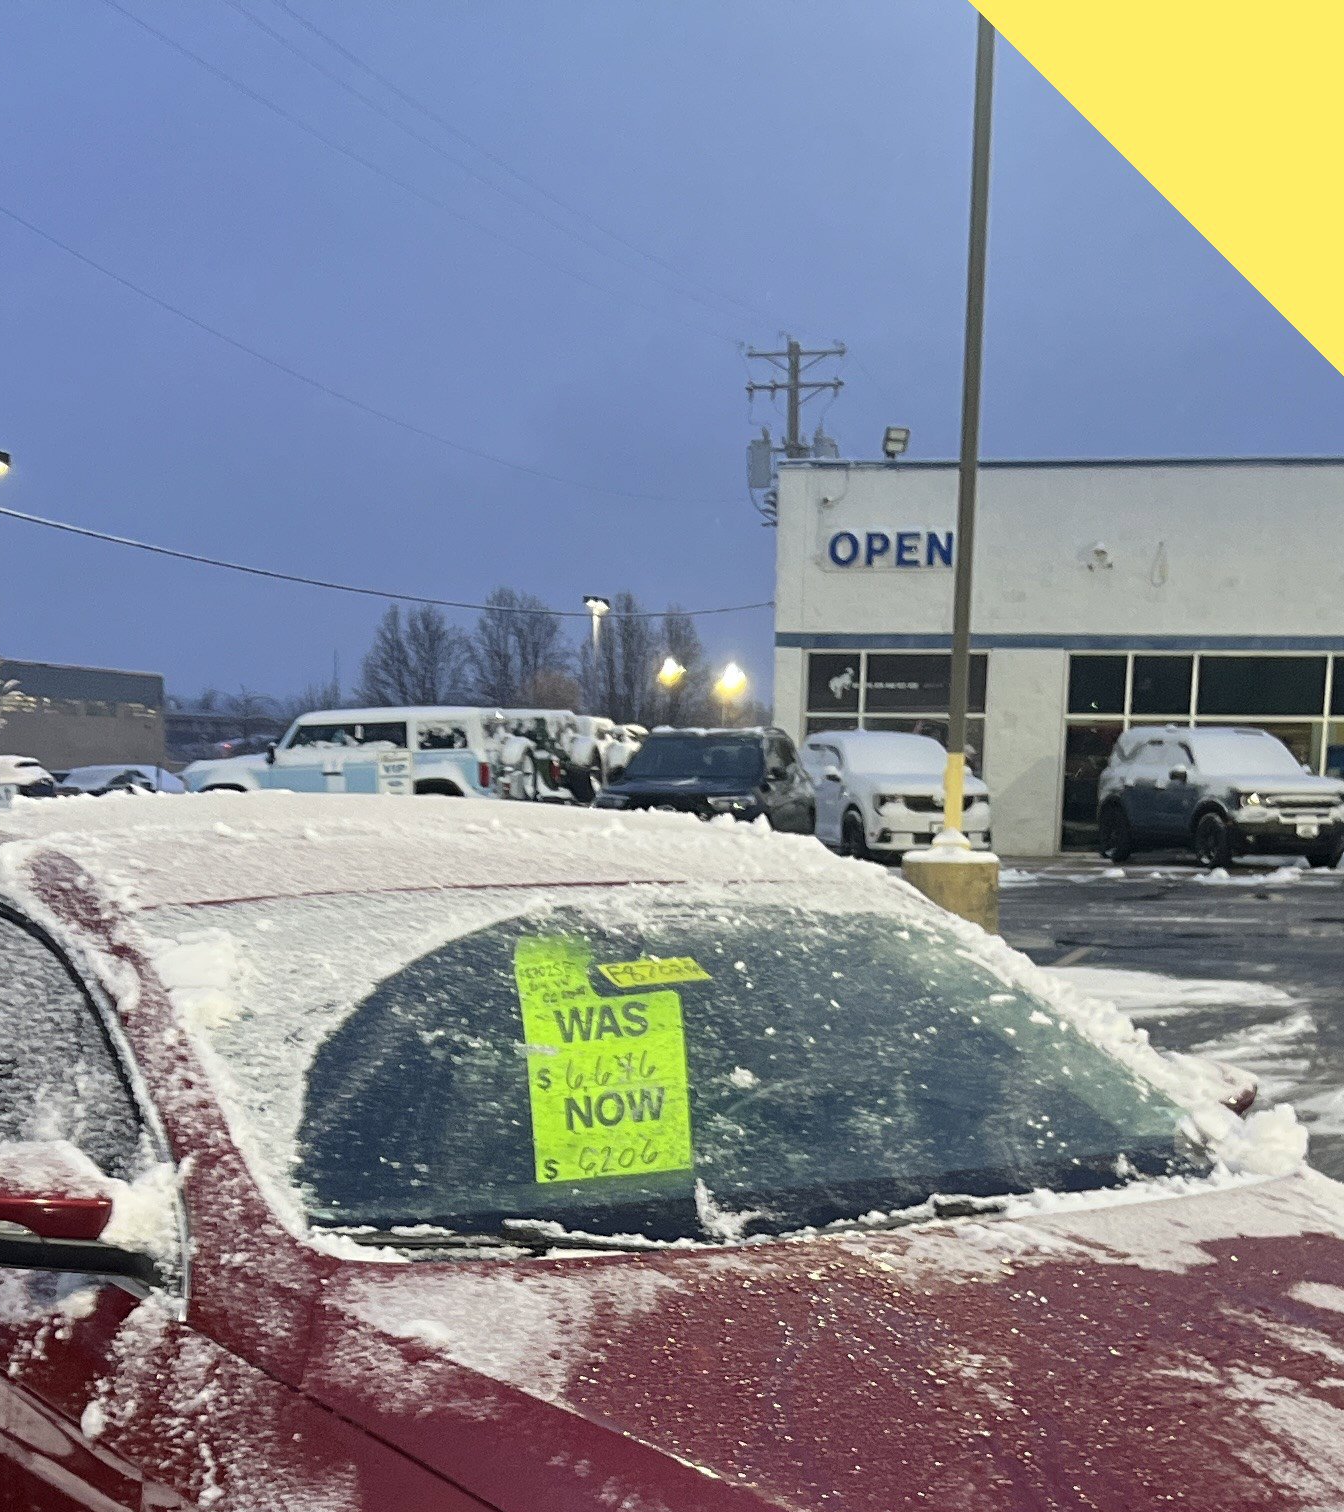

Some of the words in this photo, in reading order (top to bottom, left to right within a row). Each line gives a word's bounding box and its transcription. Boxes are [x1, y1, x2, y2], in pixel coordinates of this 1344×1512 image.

[828, 530, 954, 568] OPEN
[553, 1002, 649, 1043] WAS
[536, 1068, 552, 1091] $
[564, 1087, 665, 1131] NOW
[544, 1159, 559, 1181] $
